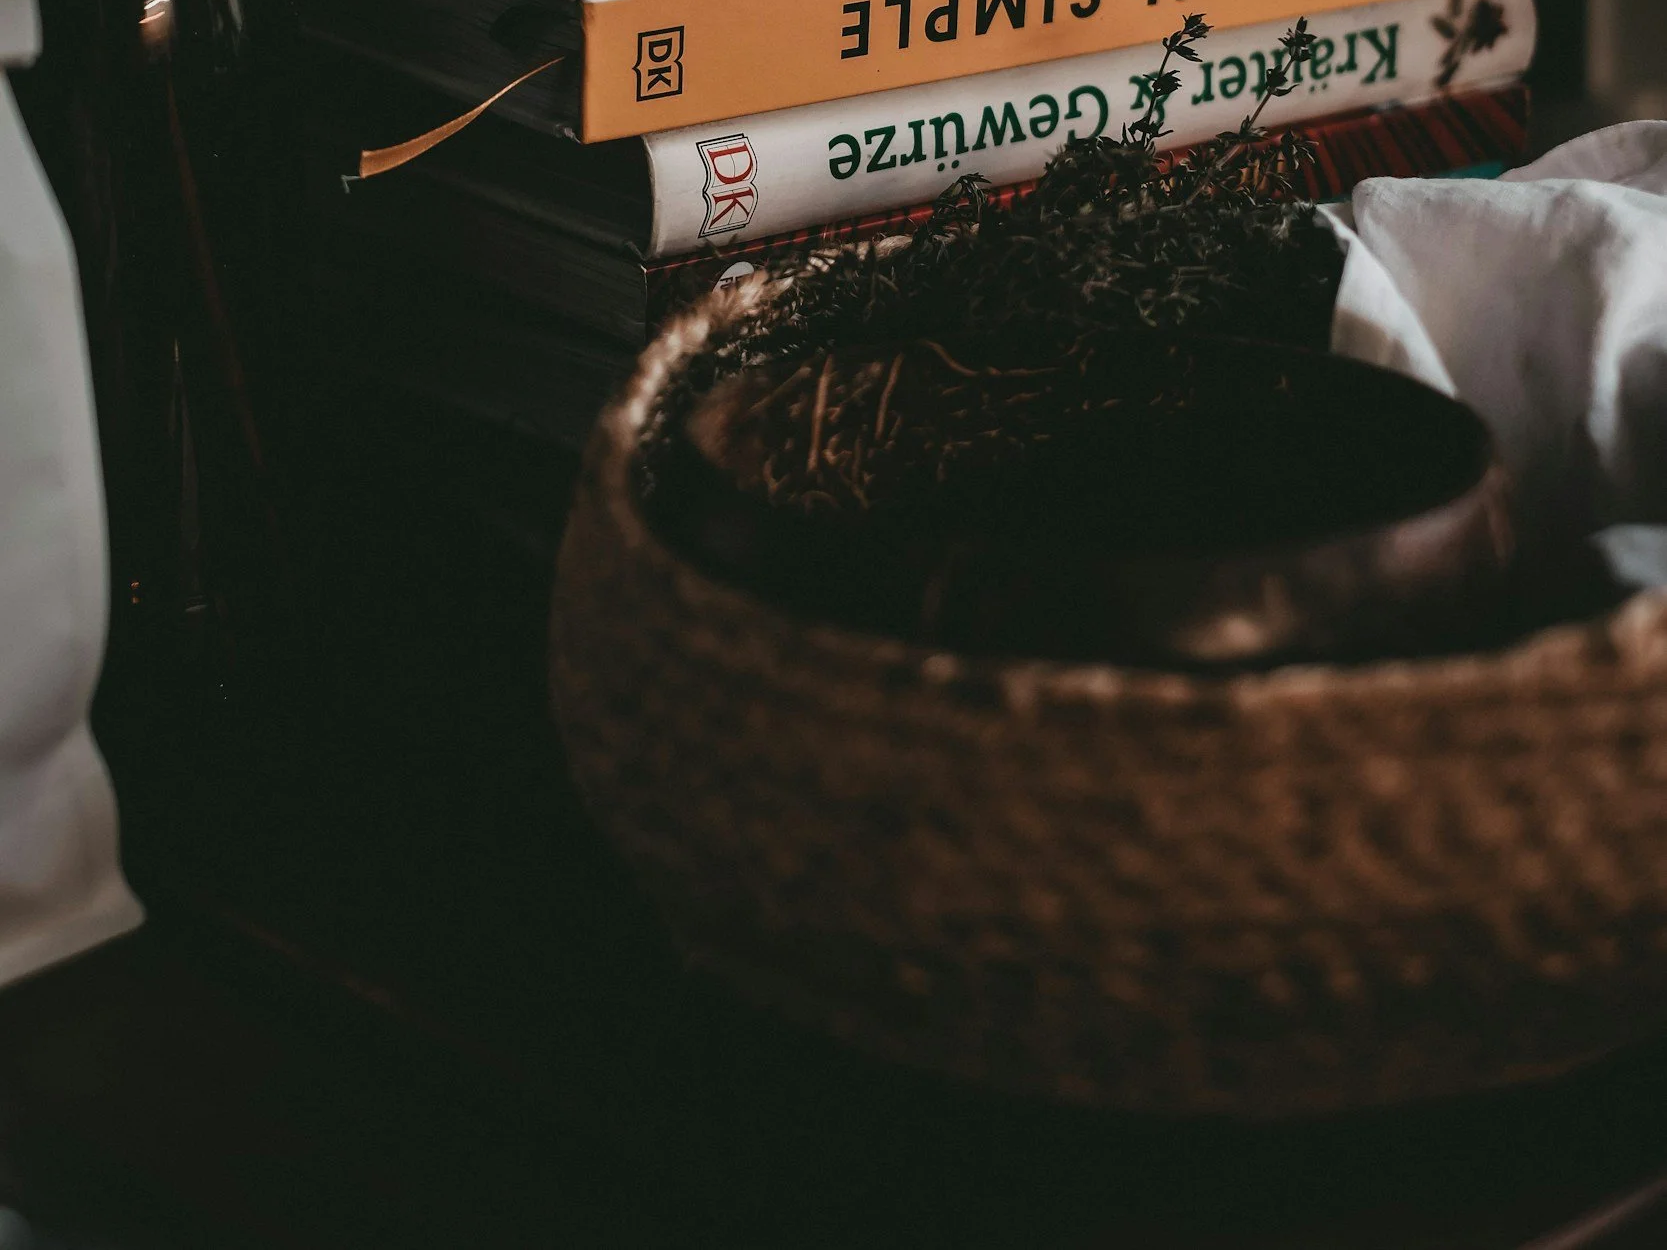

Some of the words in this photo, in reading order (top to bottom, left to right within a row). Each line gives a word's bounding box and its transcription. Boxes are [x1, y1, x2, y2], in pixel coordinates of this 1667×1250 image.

[647, 37, 673, 91] DK
[1129, 71, 1168, 128] &
[828, 85, 1109, 180] Gewürze
[707, 142, 754, 230] DK
